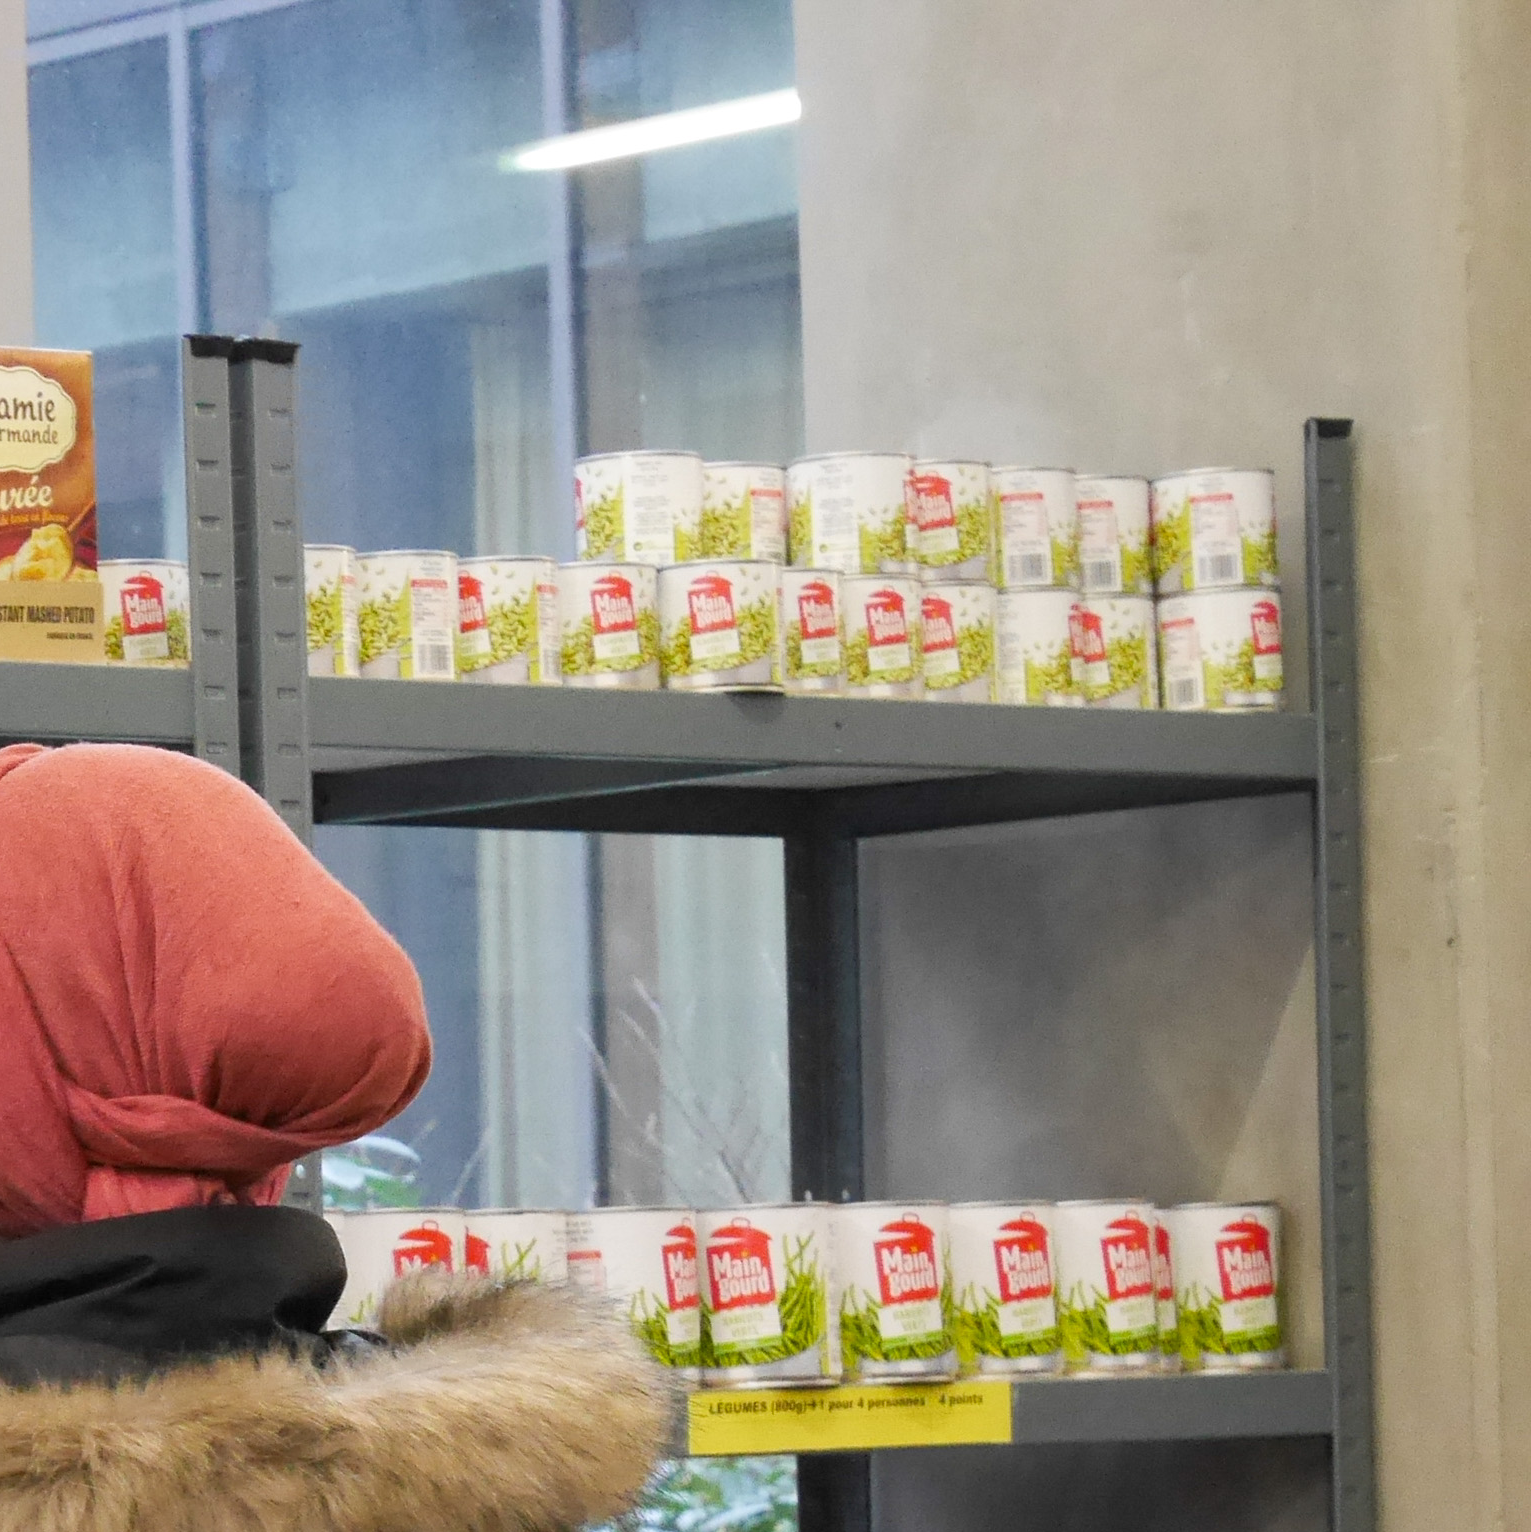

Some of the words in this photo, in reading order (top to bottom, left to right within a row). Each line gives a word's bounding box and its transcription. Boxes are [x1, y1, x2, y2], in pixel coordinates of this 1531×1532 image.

[711, 1250, 762, 1280] Main
[881, 1246, 929, 1272] Main
[1001, 1244, 1046, 1273] Main
[1222, 1245, 1267, 1272] Main
[719, 1268, 771, 1303] gourd
[889, 1263, 935, 1297] gourd
[709, 1399, 768, 1415] LÉGUMES
[828, 1400, 854, 1413] pour
[857, 1397, 864, 1409] 4
[867, 1396, 926, 1411] personnes
[939, 1393, 946, 1407] 4
[949, 1393, 984, 1408] points
